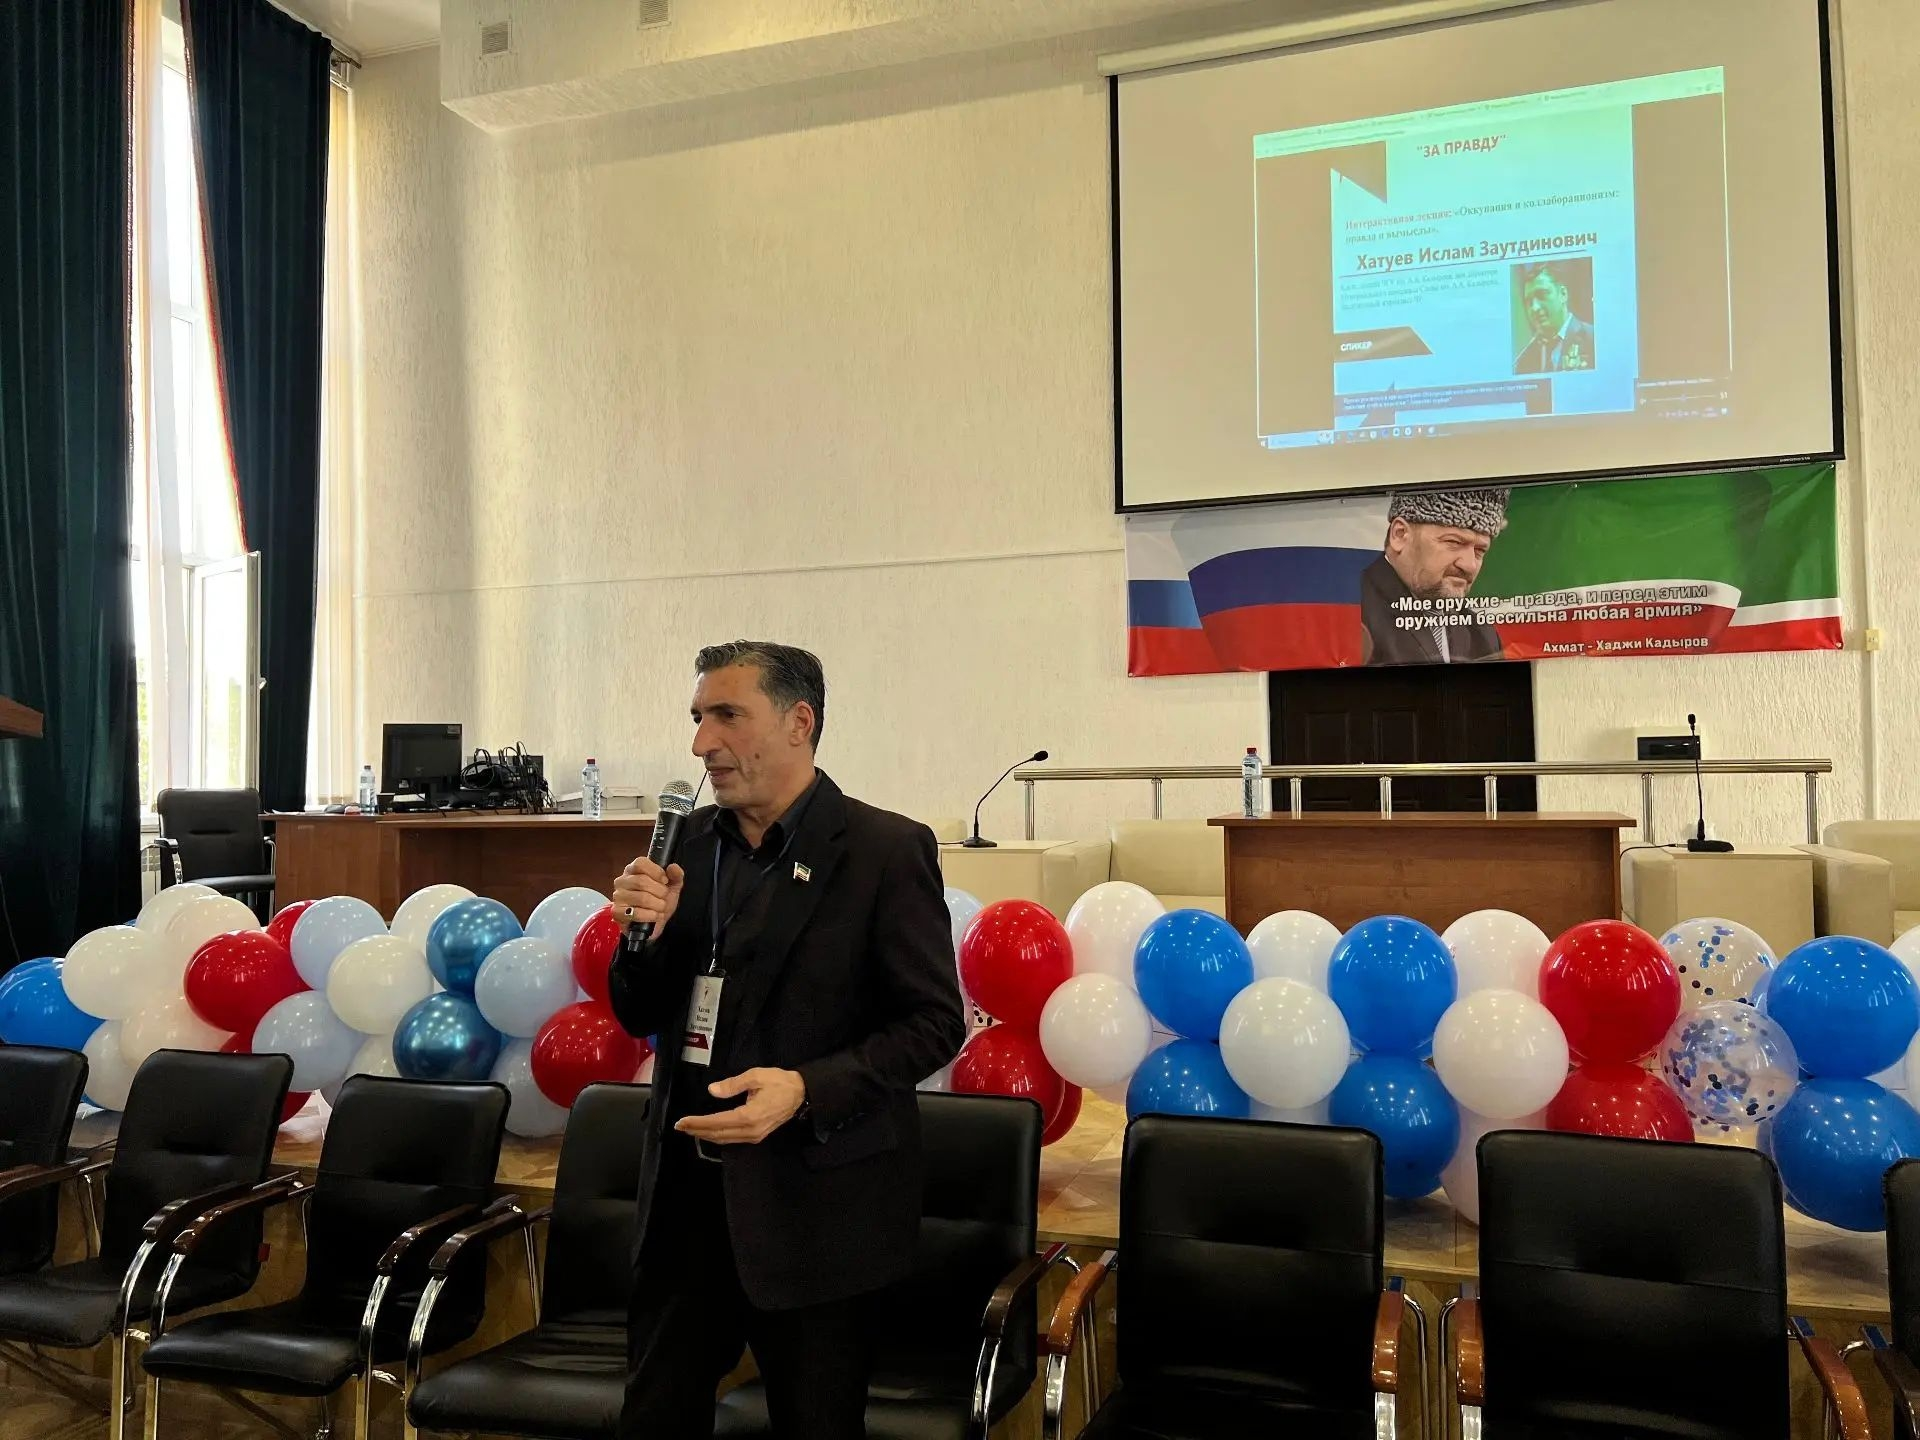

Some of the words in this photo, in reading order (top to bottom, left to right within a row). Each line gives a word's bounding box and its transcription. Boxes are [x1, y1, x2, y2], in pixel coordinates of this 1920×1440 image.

[1416, 144, 1440, 158] "ЗА
[1444, 133, 1506, 154] ПРАВДУ"
[1356, 252, 1414, 274] Хатуев
[1418, 242, 1475, 263] Ислам
[1479, 231, 1598, 259] Заутдинович
[1340, 340, 1373, 352] СПИКЕР
[1390, 596, 1432, 612] «Мое
[1435, 595, 1500, 612] оружие
[1514, 591, 1583, 610] правда,
[1586, 590, 1597, 603] и
[1601, 586, 1656, 604] перед
[1658, 584, 1708, 600] этим
[1395, 613, 1472, 631] оружием
[1476, 608, 1568, 627] бессильна
[1571, 604, 1630, 621] любая
[1633, 603, 1703, 621] армия»
[1543, 641, 1585, 653] Ахмат
[1596, 639, 1642, 652] Хаджи
[1645, 636, 1709, 650] Кадыров
